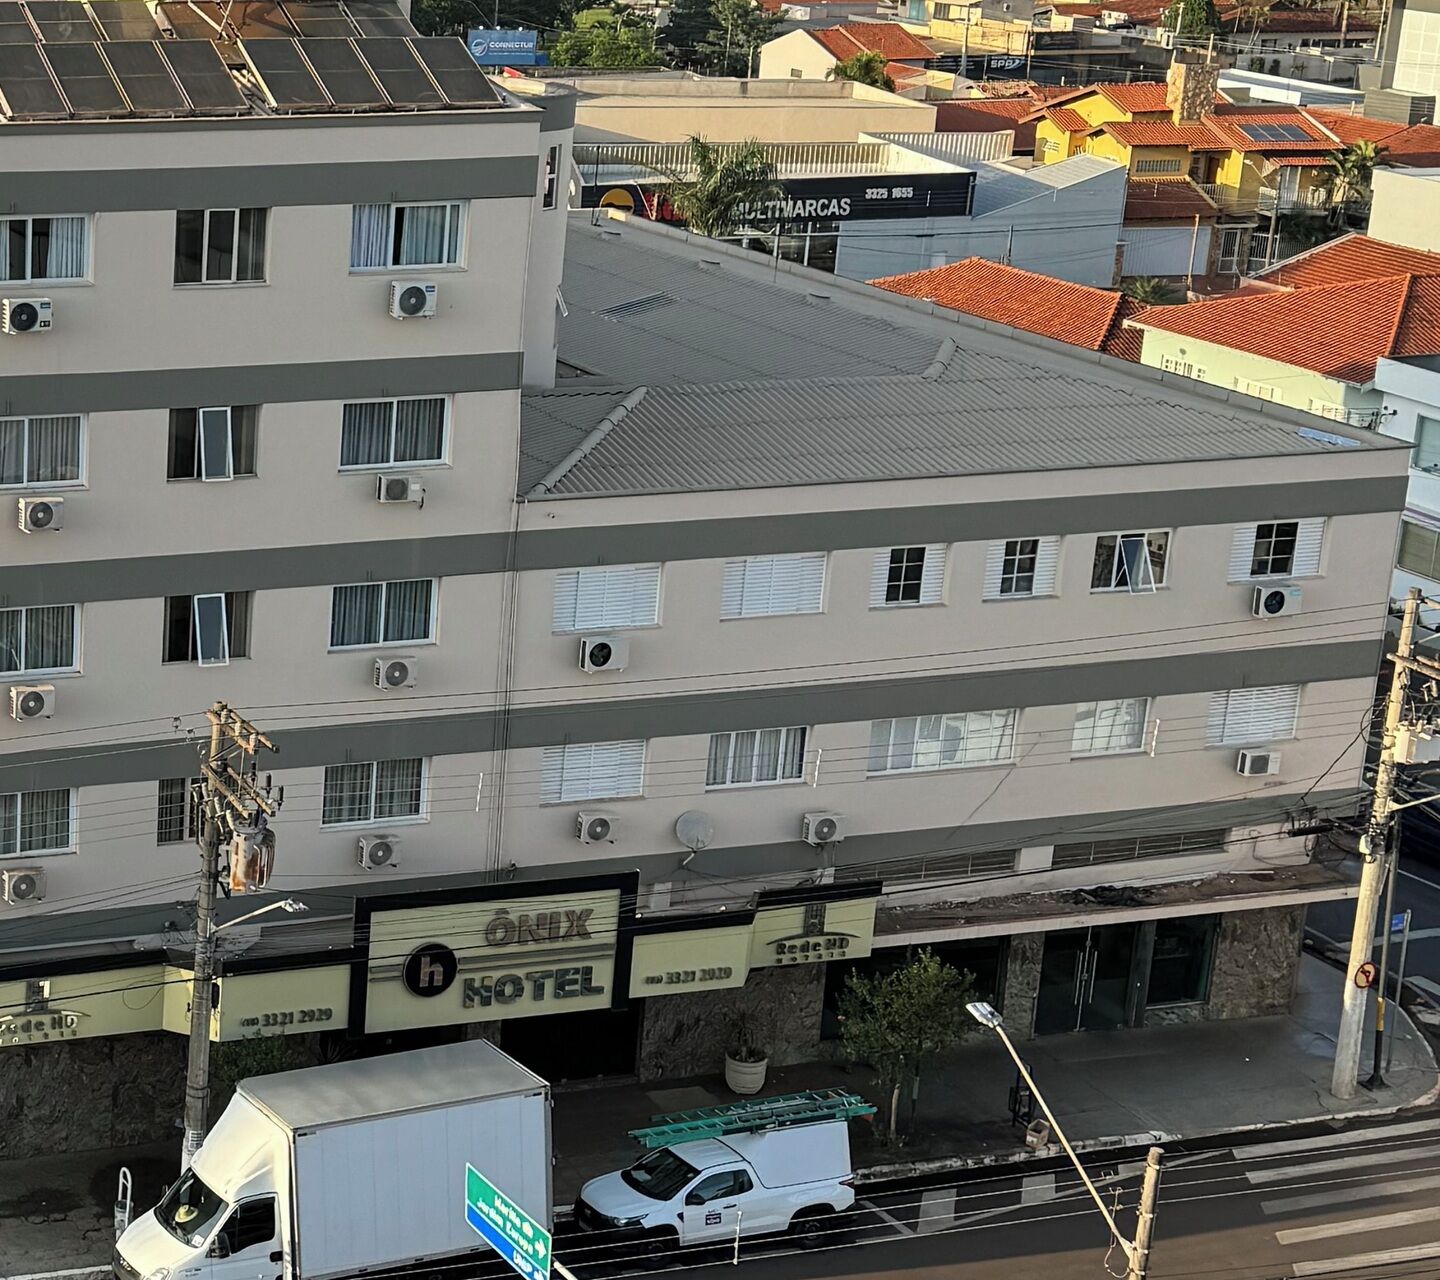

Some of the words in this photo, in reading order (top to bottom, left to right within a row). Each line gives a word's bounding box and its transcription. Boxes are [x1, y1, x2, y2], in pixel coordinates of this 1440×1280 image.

[865, 187, 889, 199] 3325
[486, 907, 595, 947] ÔNIX
[776, 939, 822, 956] Rede
[463, 965, 605, 1009] HOTEL
[261, 1011, 294, 1027] 3321
